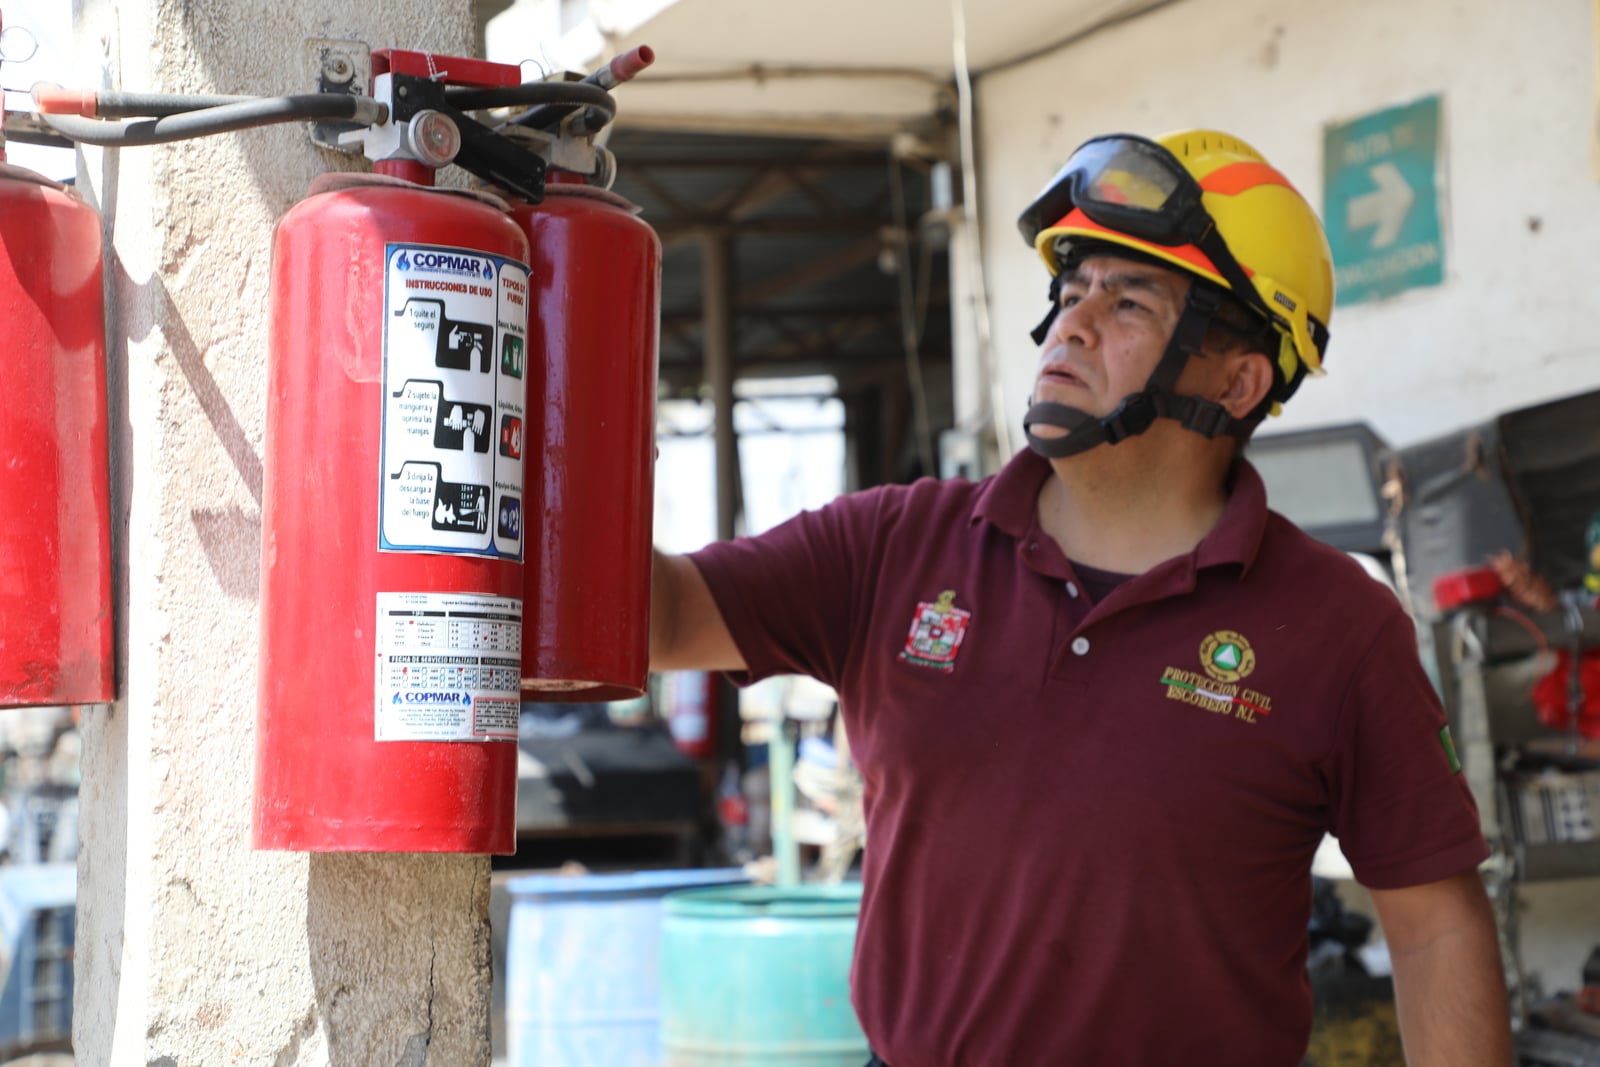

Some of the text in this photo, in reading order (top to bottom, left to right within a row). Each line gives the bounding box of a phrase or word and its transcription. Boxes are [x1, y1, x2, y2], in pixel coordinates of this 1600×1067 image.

[413, 253, 480, 273] COPMAR
[405, 279, 493, 298] INSTRUCCIONES DE USO
[410, 308, 436, 320] 1 quite el
[414, 321, 435, 332] seguro
[423, 414, 433, 424] las
[399, 484, 427, 495] descarga
[415, 496, 430, 505] base
[412, 508, 430, 518] fuego
[391, 655, 410, 663] FECHA
[421, 656, 448, 664] SERVICIO
[449, 657, 478, 665] REALIZADO
[1163, 665, 1272, 712] PROTECCION CIVIL
[405, 691, 460, 703] COPMAR
[1166, 684, 1233, 715] ESCOBEDO
